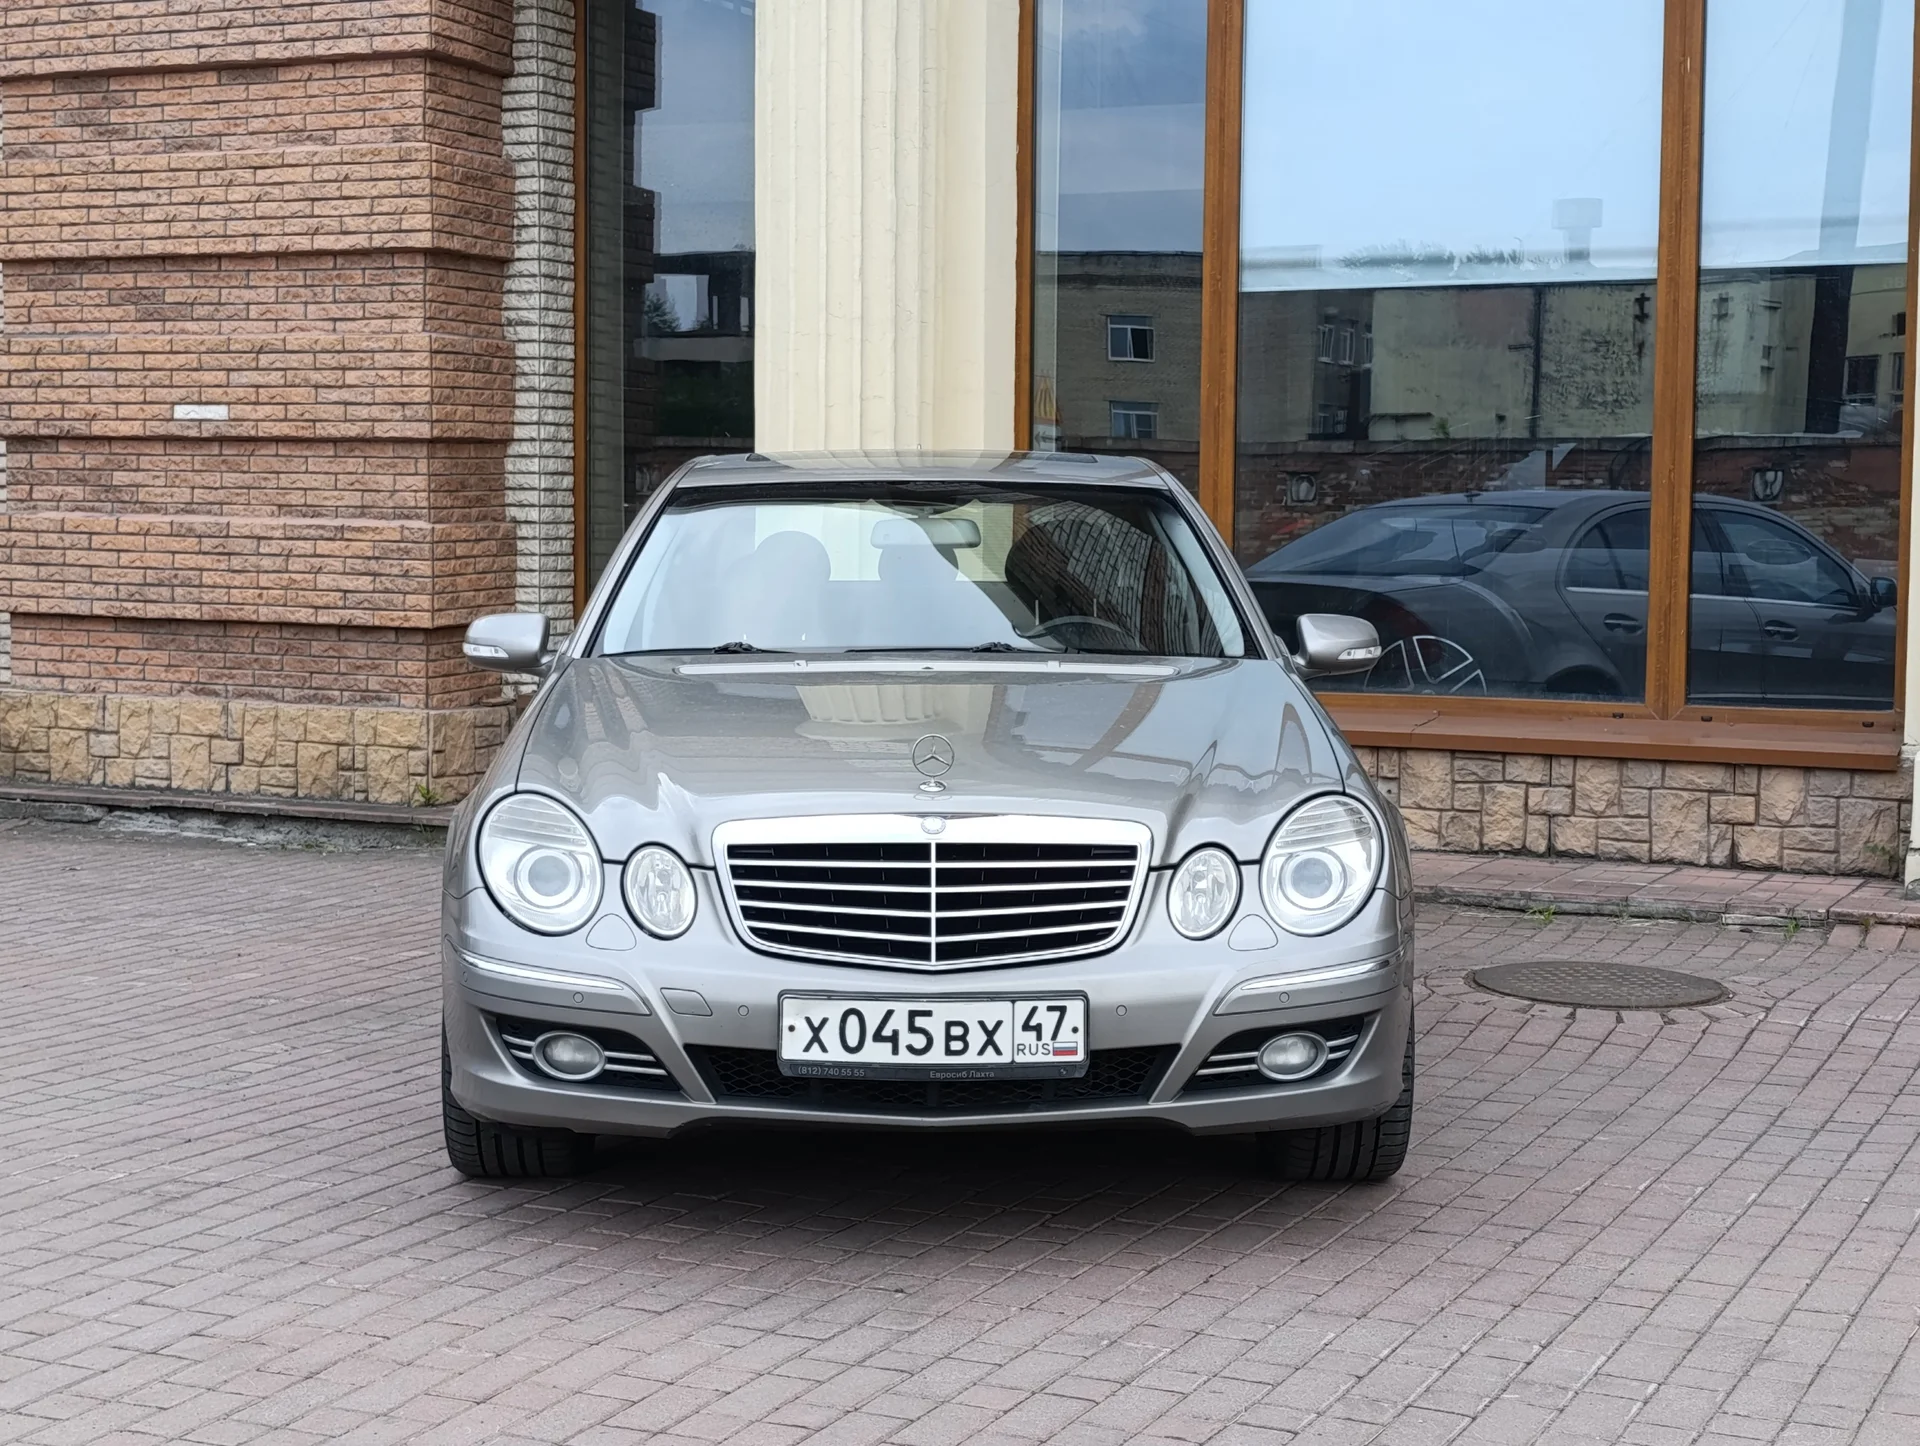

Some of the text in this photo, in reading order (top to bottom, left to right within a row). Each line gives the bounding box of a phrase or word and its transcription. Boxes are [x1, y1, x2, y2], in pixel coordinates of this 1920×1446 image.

[802, 1005, 1067, 1057] Х045ВХ 47
[1016, 1042, 1051, 1056] RUS
[798, 1066, 866, 1078] (812) 740 55 55
[929, 1070, 996, 1080] Евросиб Лахта
